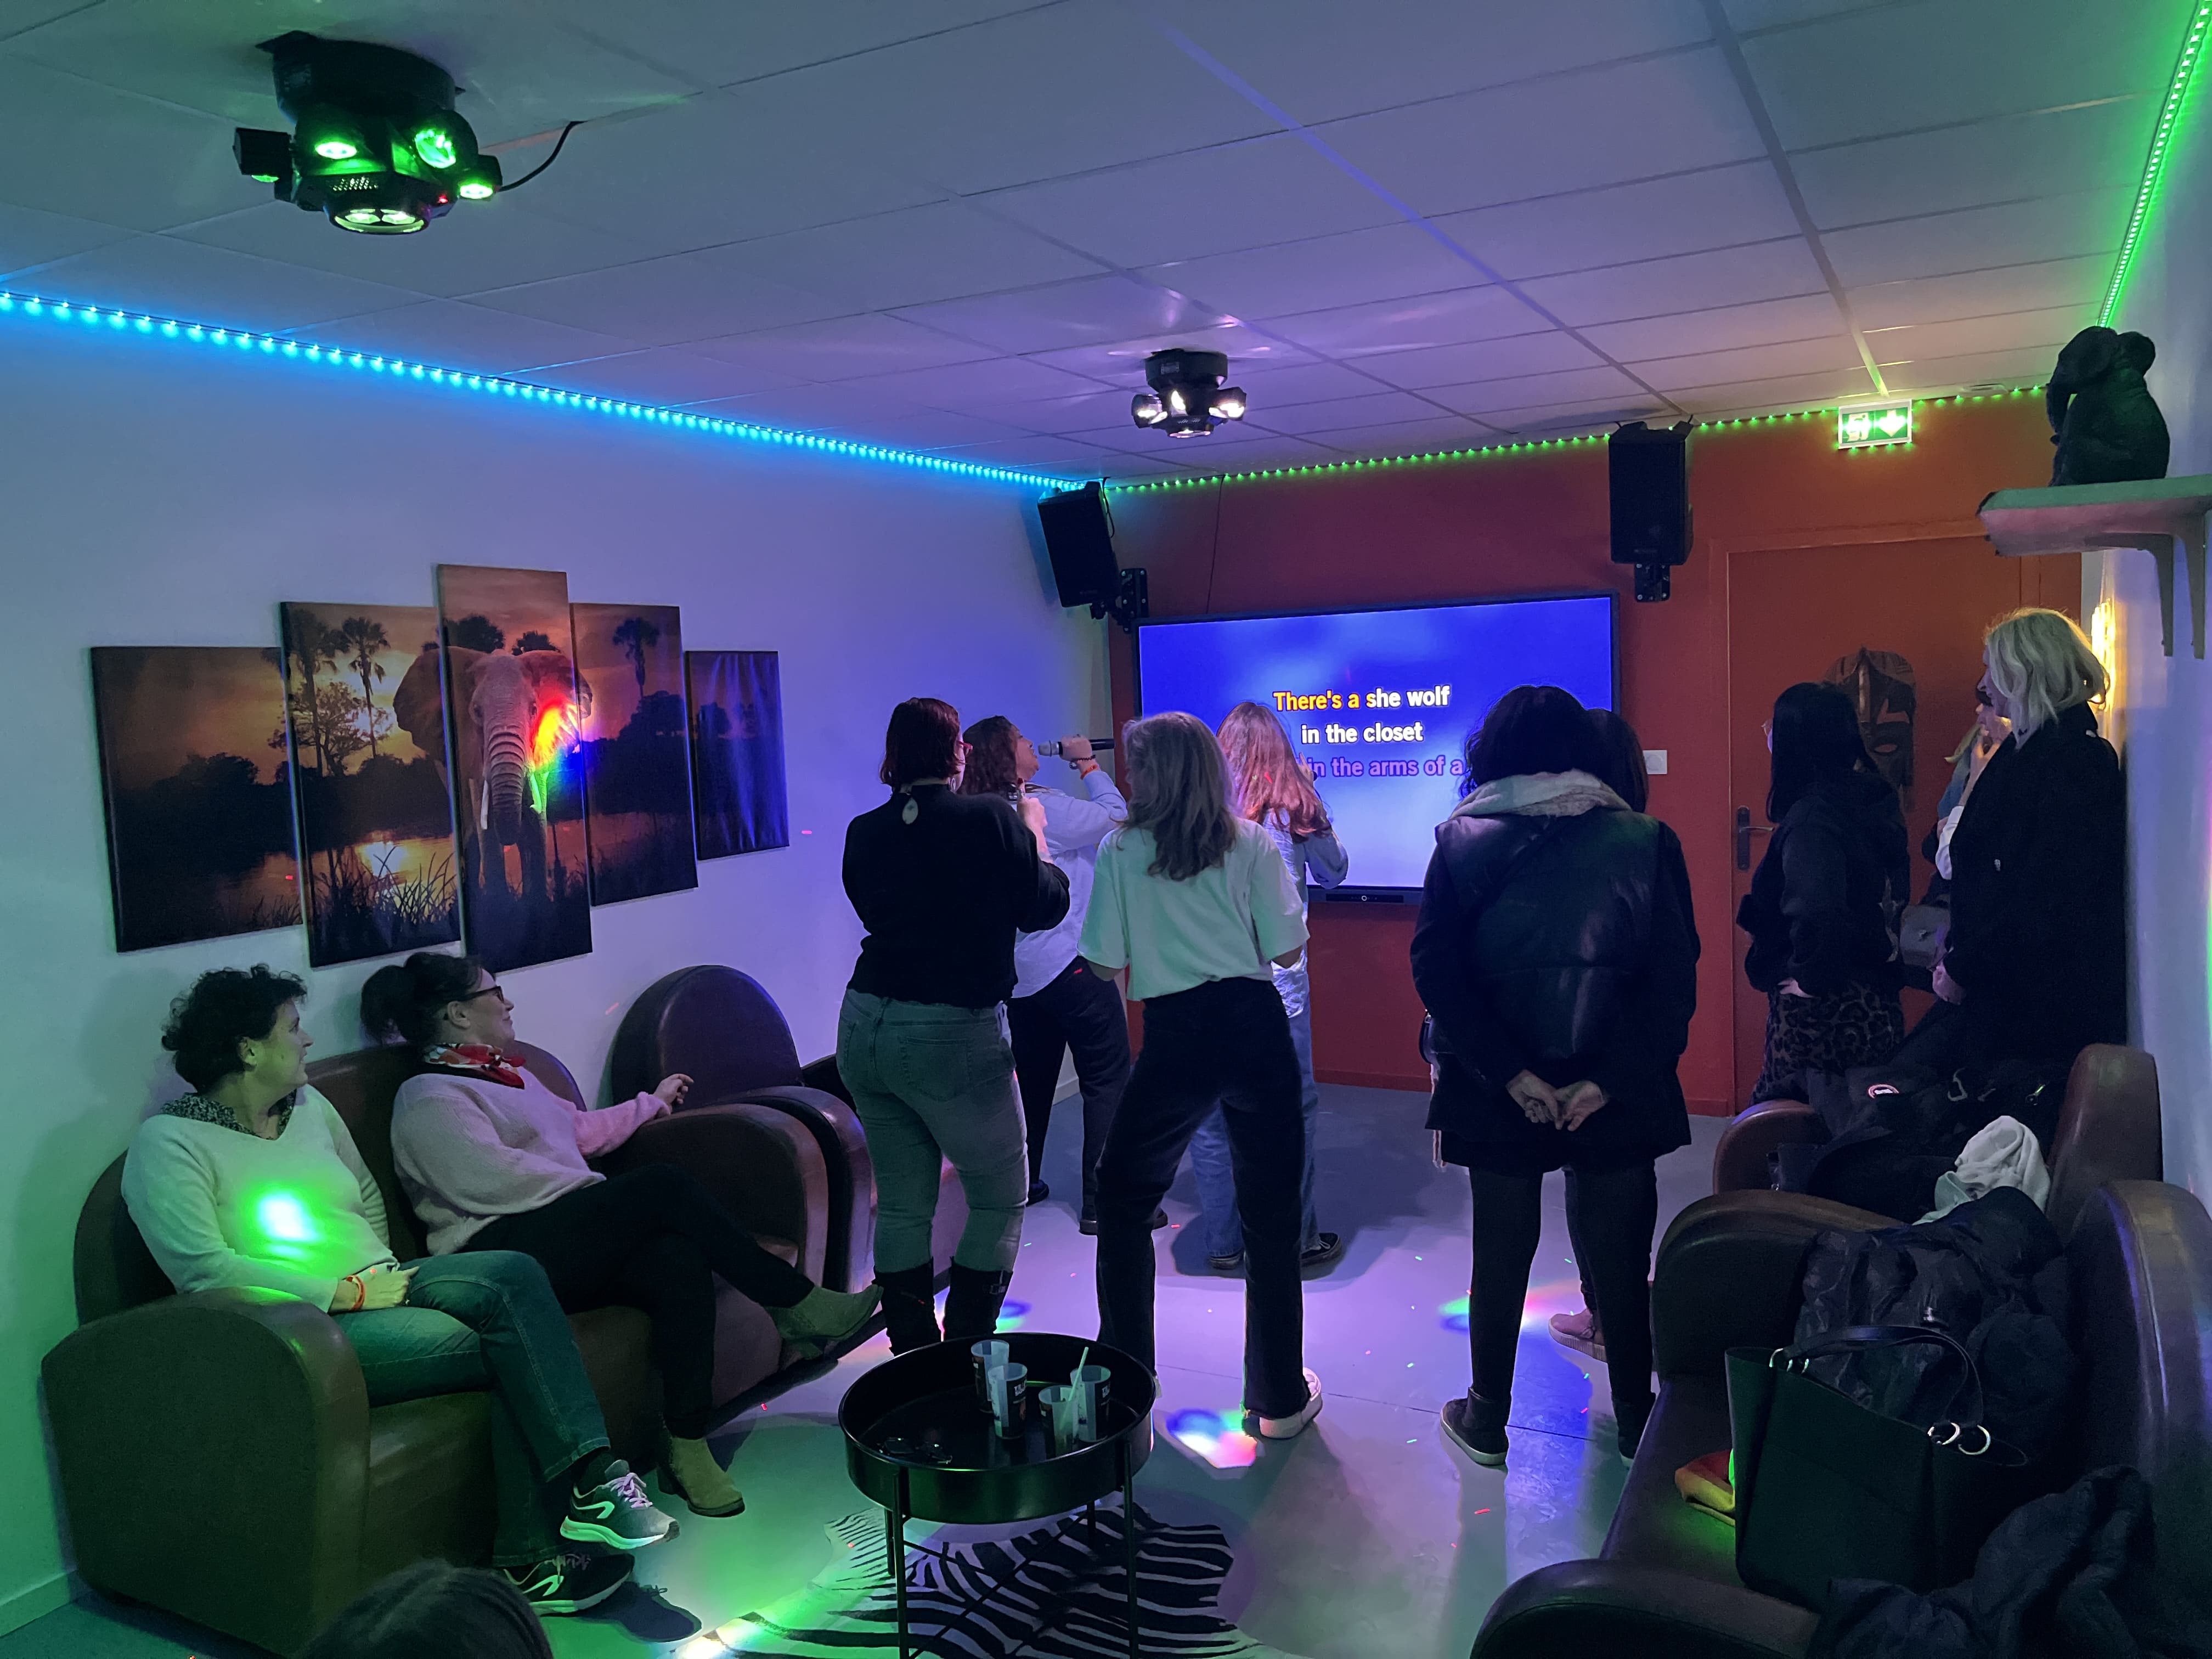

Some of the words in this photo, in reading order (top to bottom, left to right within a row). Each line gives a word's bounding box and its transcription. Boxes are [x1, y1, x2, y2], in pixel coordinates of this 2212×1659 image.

[1273, 690, 1342, 711] There's
[1347, 693, 1361, 709] a
[1366, 687, 1401, 708] she
[1407, 685, 1451, 707] wolf
[1301, 724, 1320, 744] in
[1325, 723, 1358, 743] the
[1363, 721, 1423, 743] closet
[1331, 757, 1363, 777] the
[1369, 760, 1419, 777] arms
[1424, 755, 1446, 776] of
[1450, 759, 1464, 776] a
